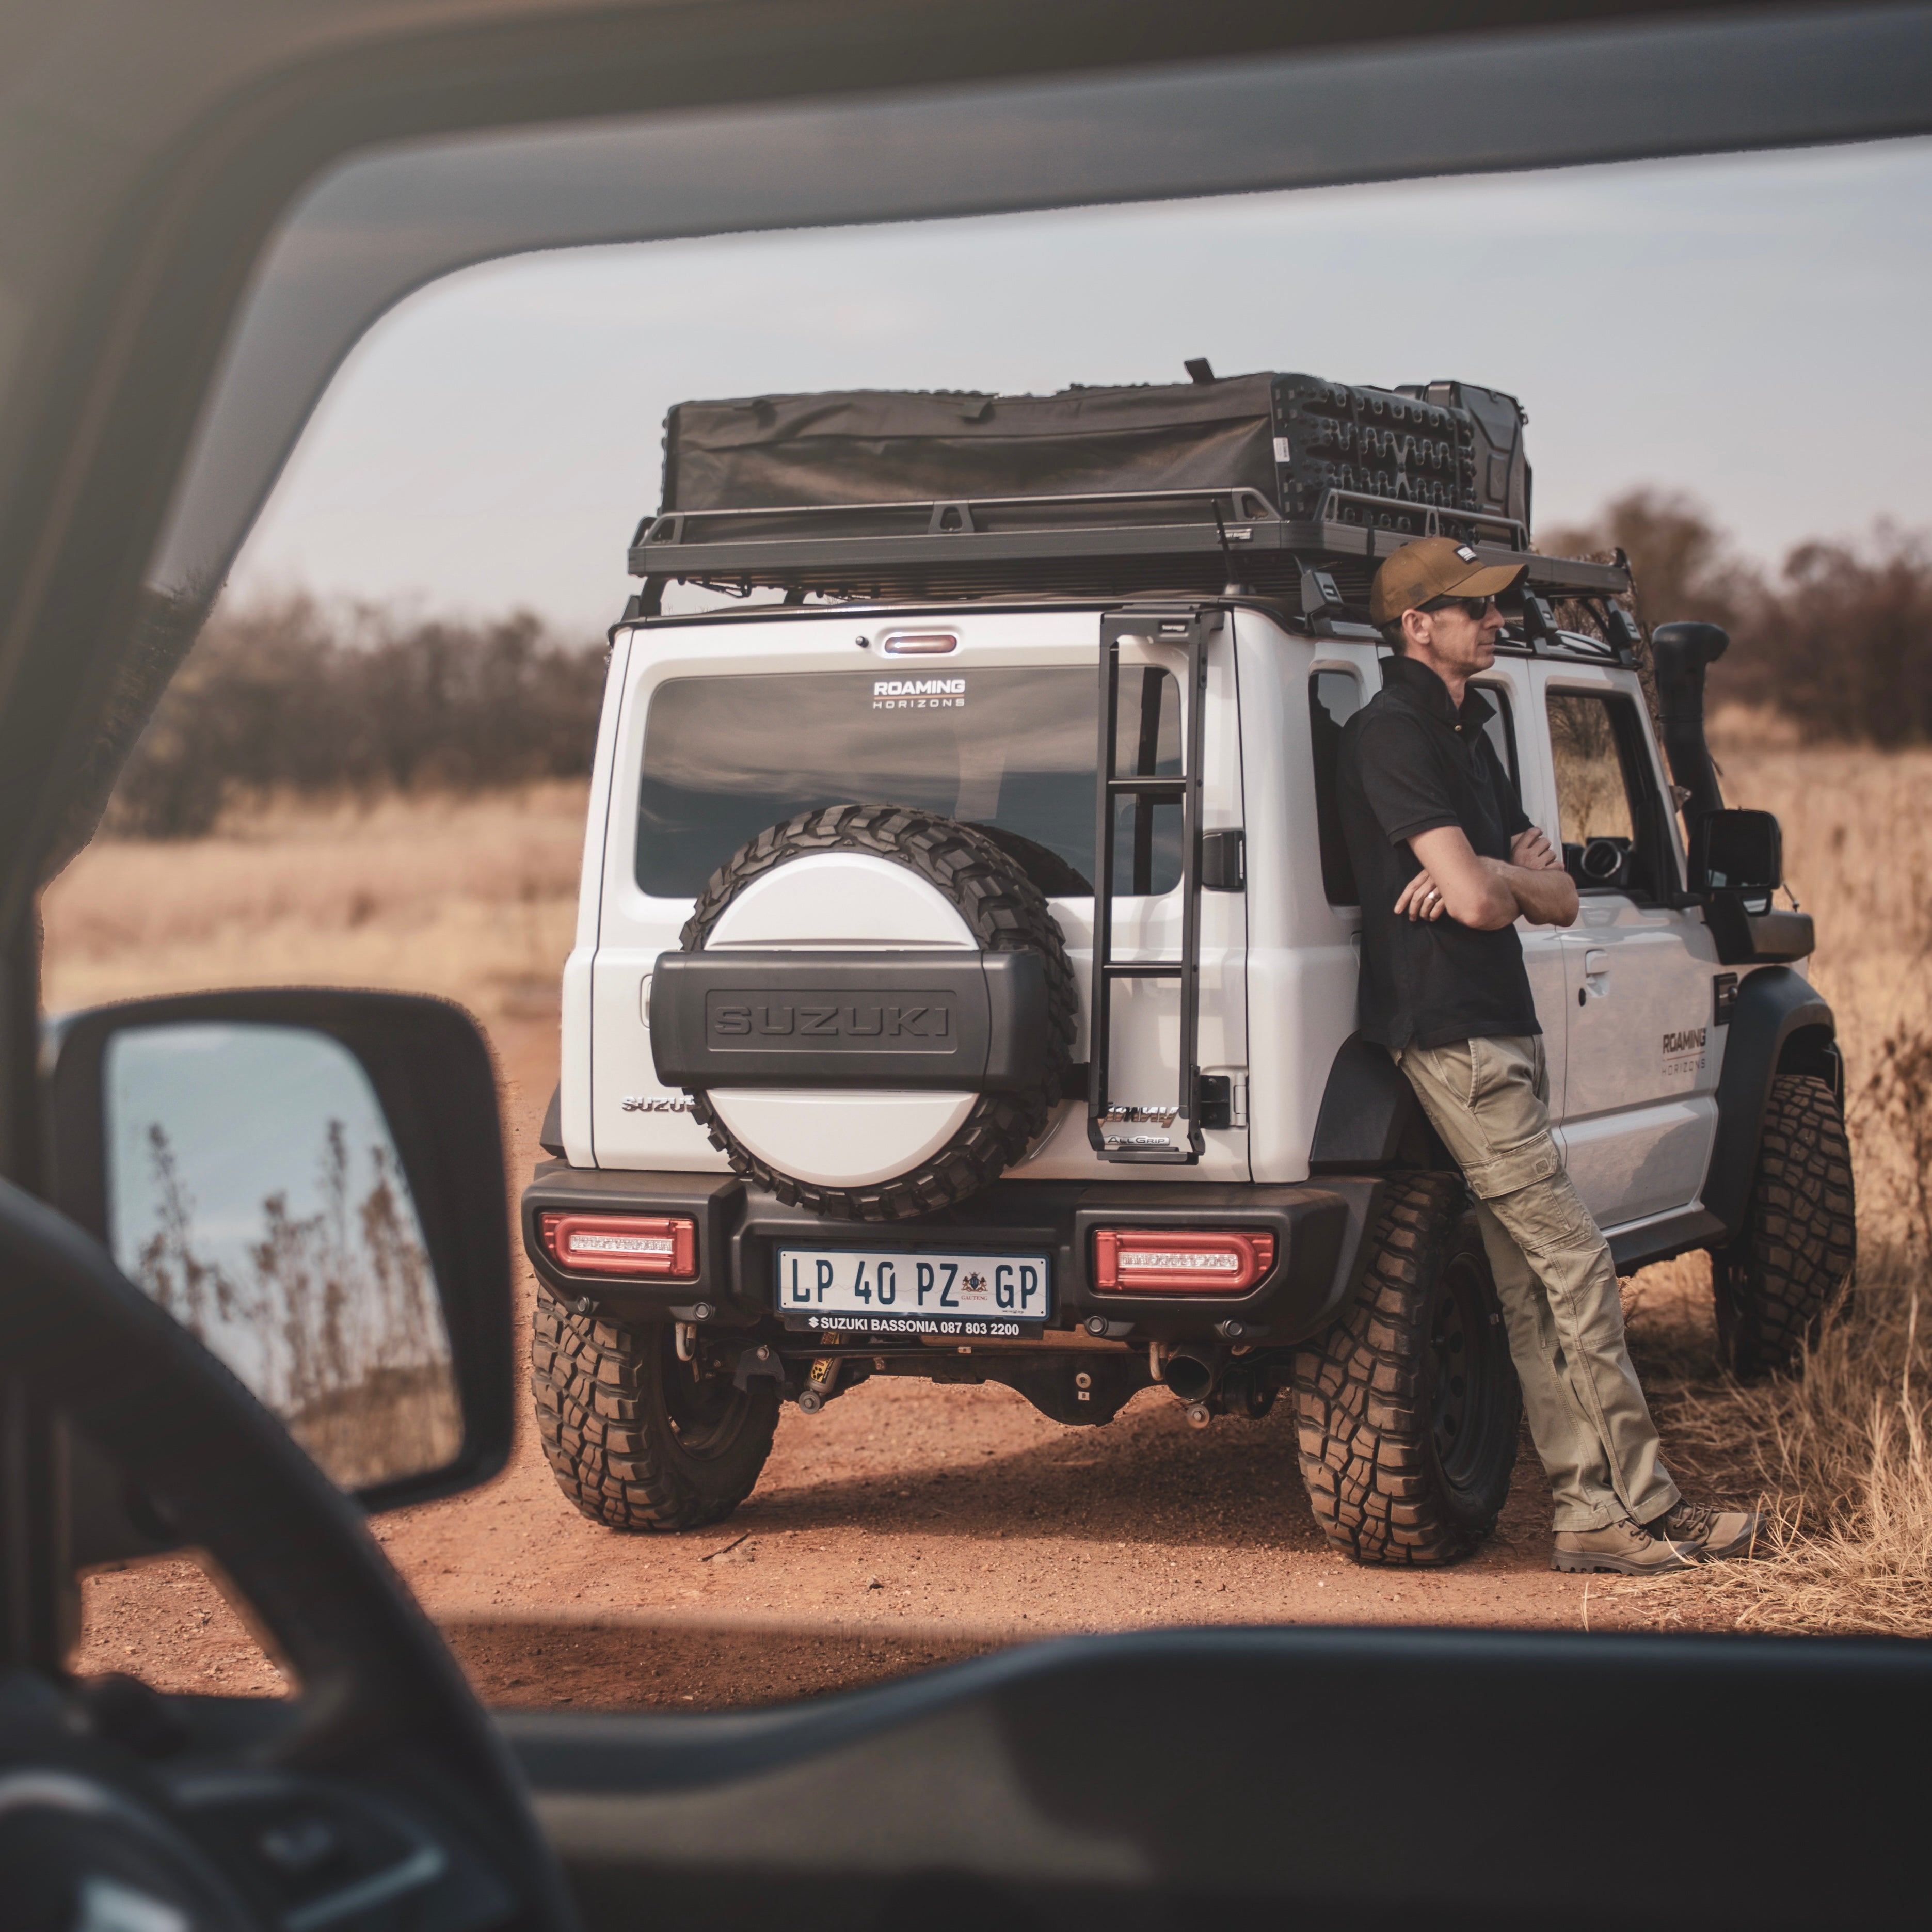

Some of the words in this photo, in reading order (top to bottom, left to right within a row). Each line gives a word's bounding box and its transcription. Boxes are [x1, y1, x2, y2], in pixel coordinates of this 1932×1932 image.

[874, 679, 965, 695] ROAMING
[873, 698, 965, 709] HORIZONS
[714, 1007, 949, 1036] SUZUKI
[1663, 1028, 1706, 1054] ROAMING
[1662, 1059, 1705, 1076] HORIZONS
[621, 1096, 695, 1112] SUZU
[792, 1259, 834, 1303] LP
[854, 1260, 896, 1305] 40
[916, 1262, 959, 1307] PZ
[995, 1265, 1038, 1310] GP
[820, 1317, 868, 1330] SUZUKI
[871, 1319, 939, 1333] BASSONIA
[940, 1321, 962, 1334] 087
[965, 1322, 987, 1335] 803
[990, 1323, 1019, 1336] 2200
